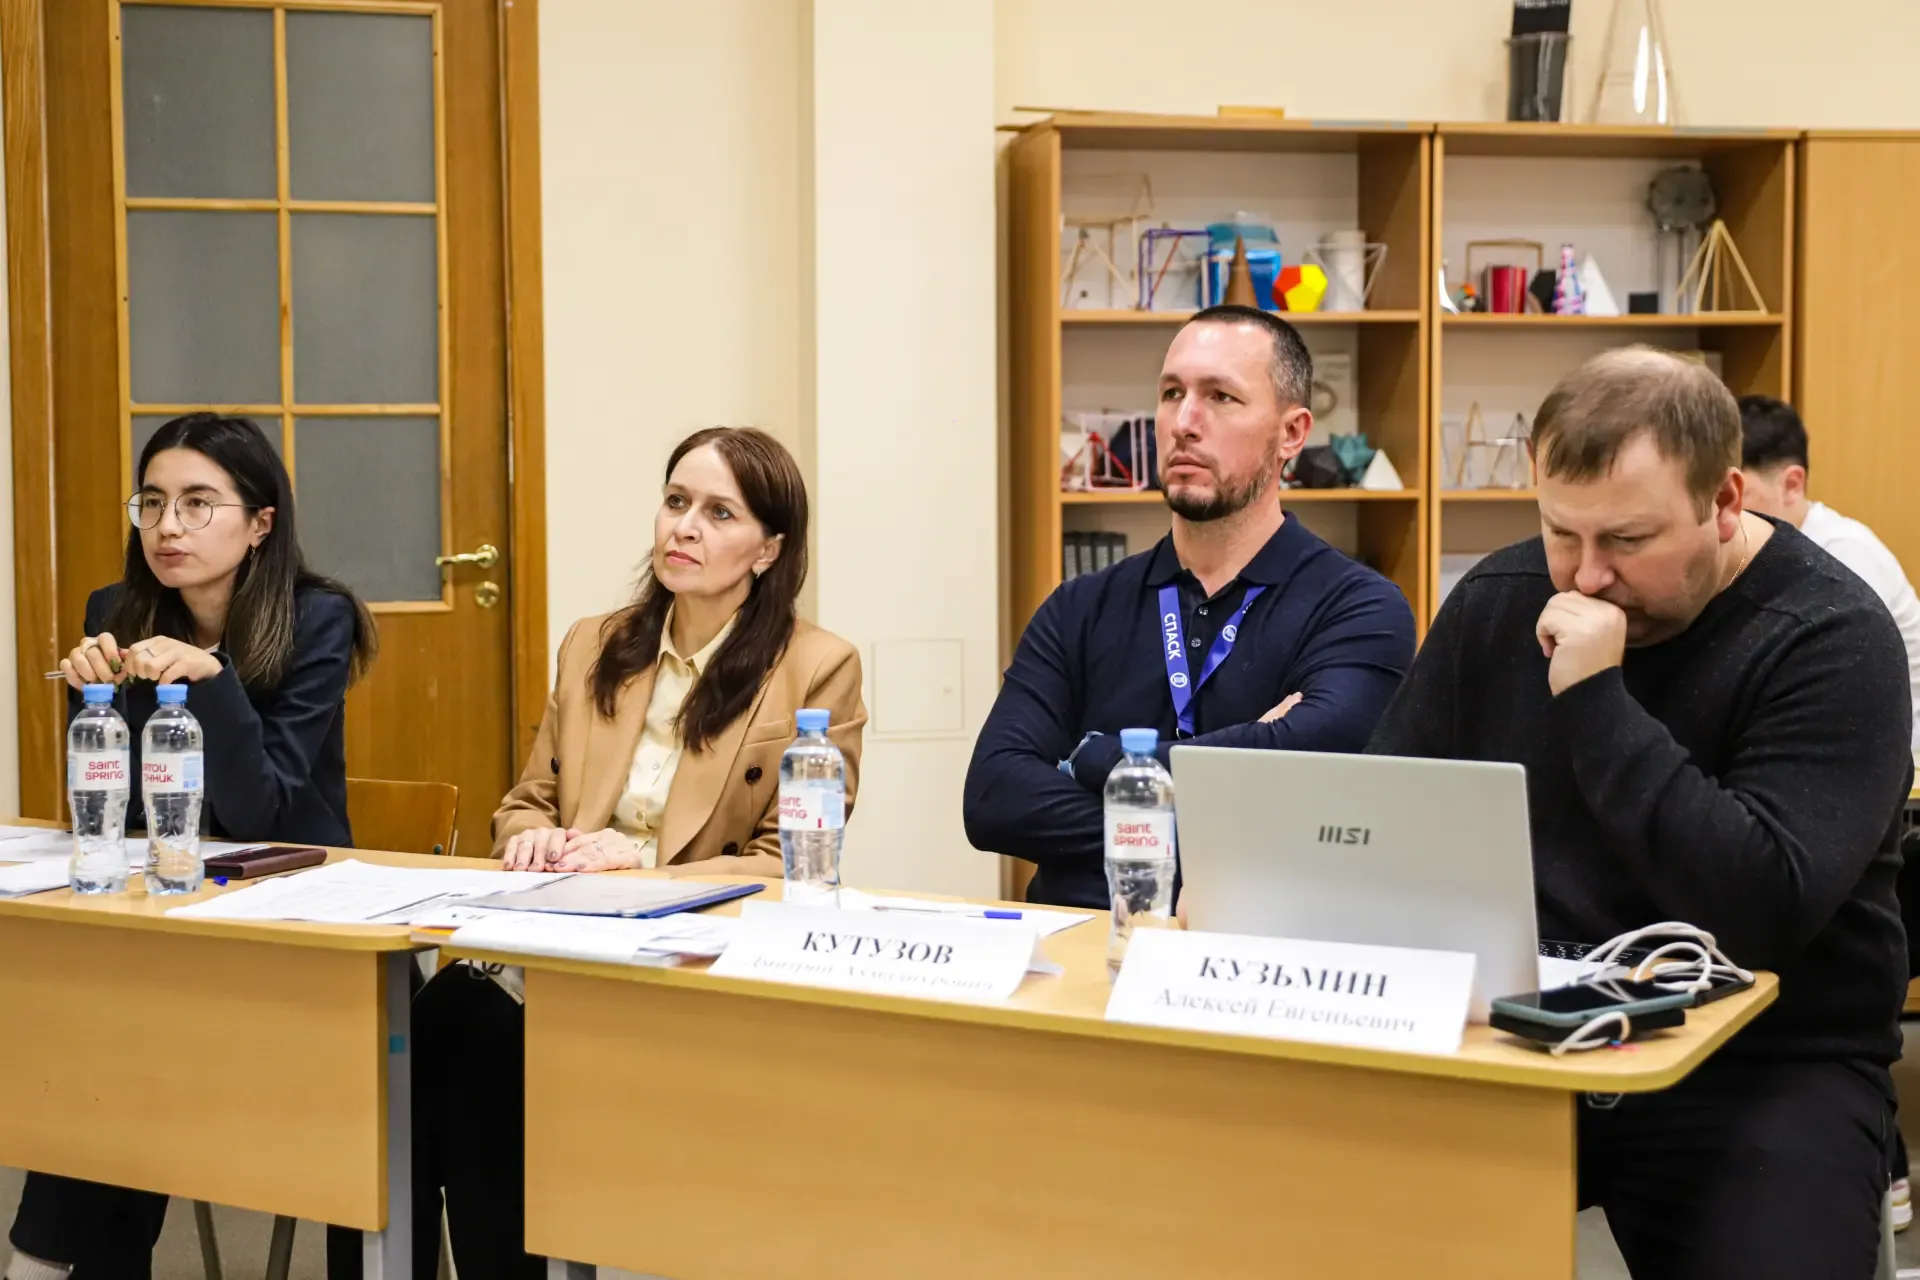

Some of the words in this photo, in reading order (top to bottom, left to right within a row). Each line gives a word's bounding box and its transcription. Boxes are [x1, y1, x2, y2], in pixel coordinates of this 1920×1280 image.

[1163, 612, 1182, 661] СПАСК
[85, 770, 125, 781] SPRING
[1112, 834, 1160, 848] SPRING
[1318, 824, 1371, 846] MSI
[801, 930, 954, 965] КУТУЗОВ
[1198, 956, 1389, 998] КУЗЬМИН
[1152, 987, 1260, 1017] Алексей
[1267, 997, 1417, 1033] Евгеньевич
